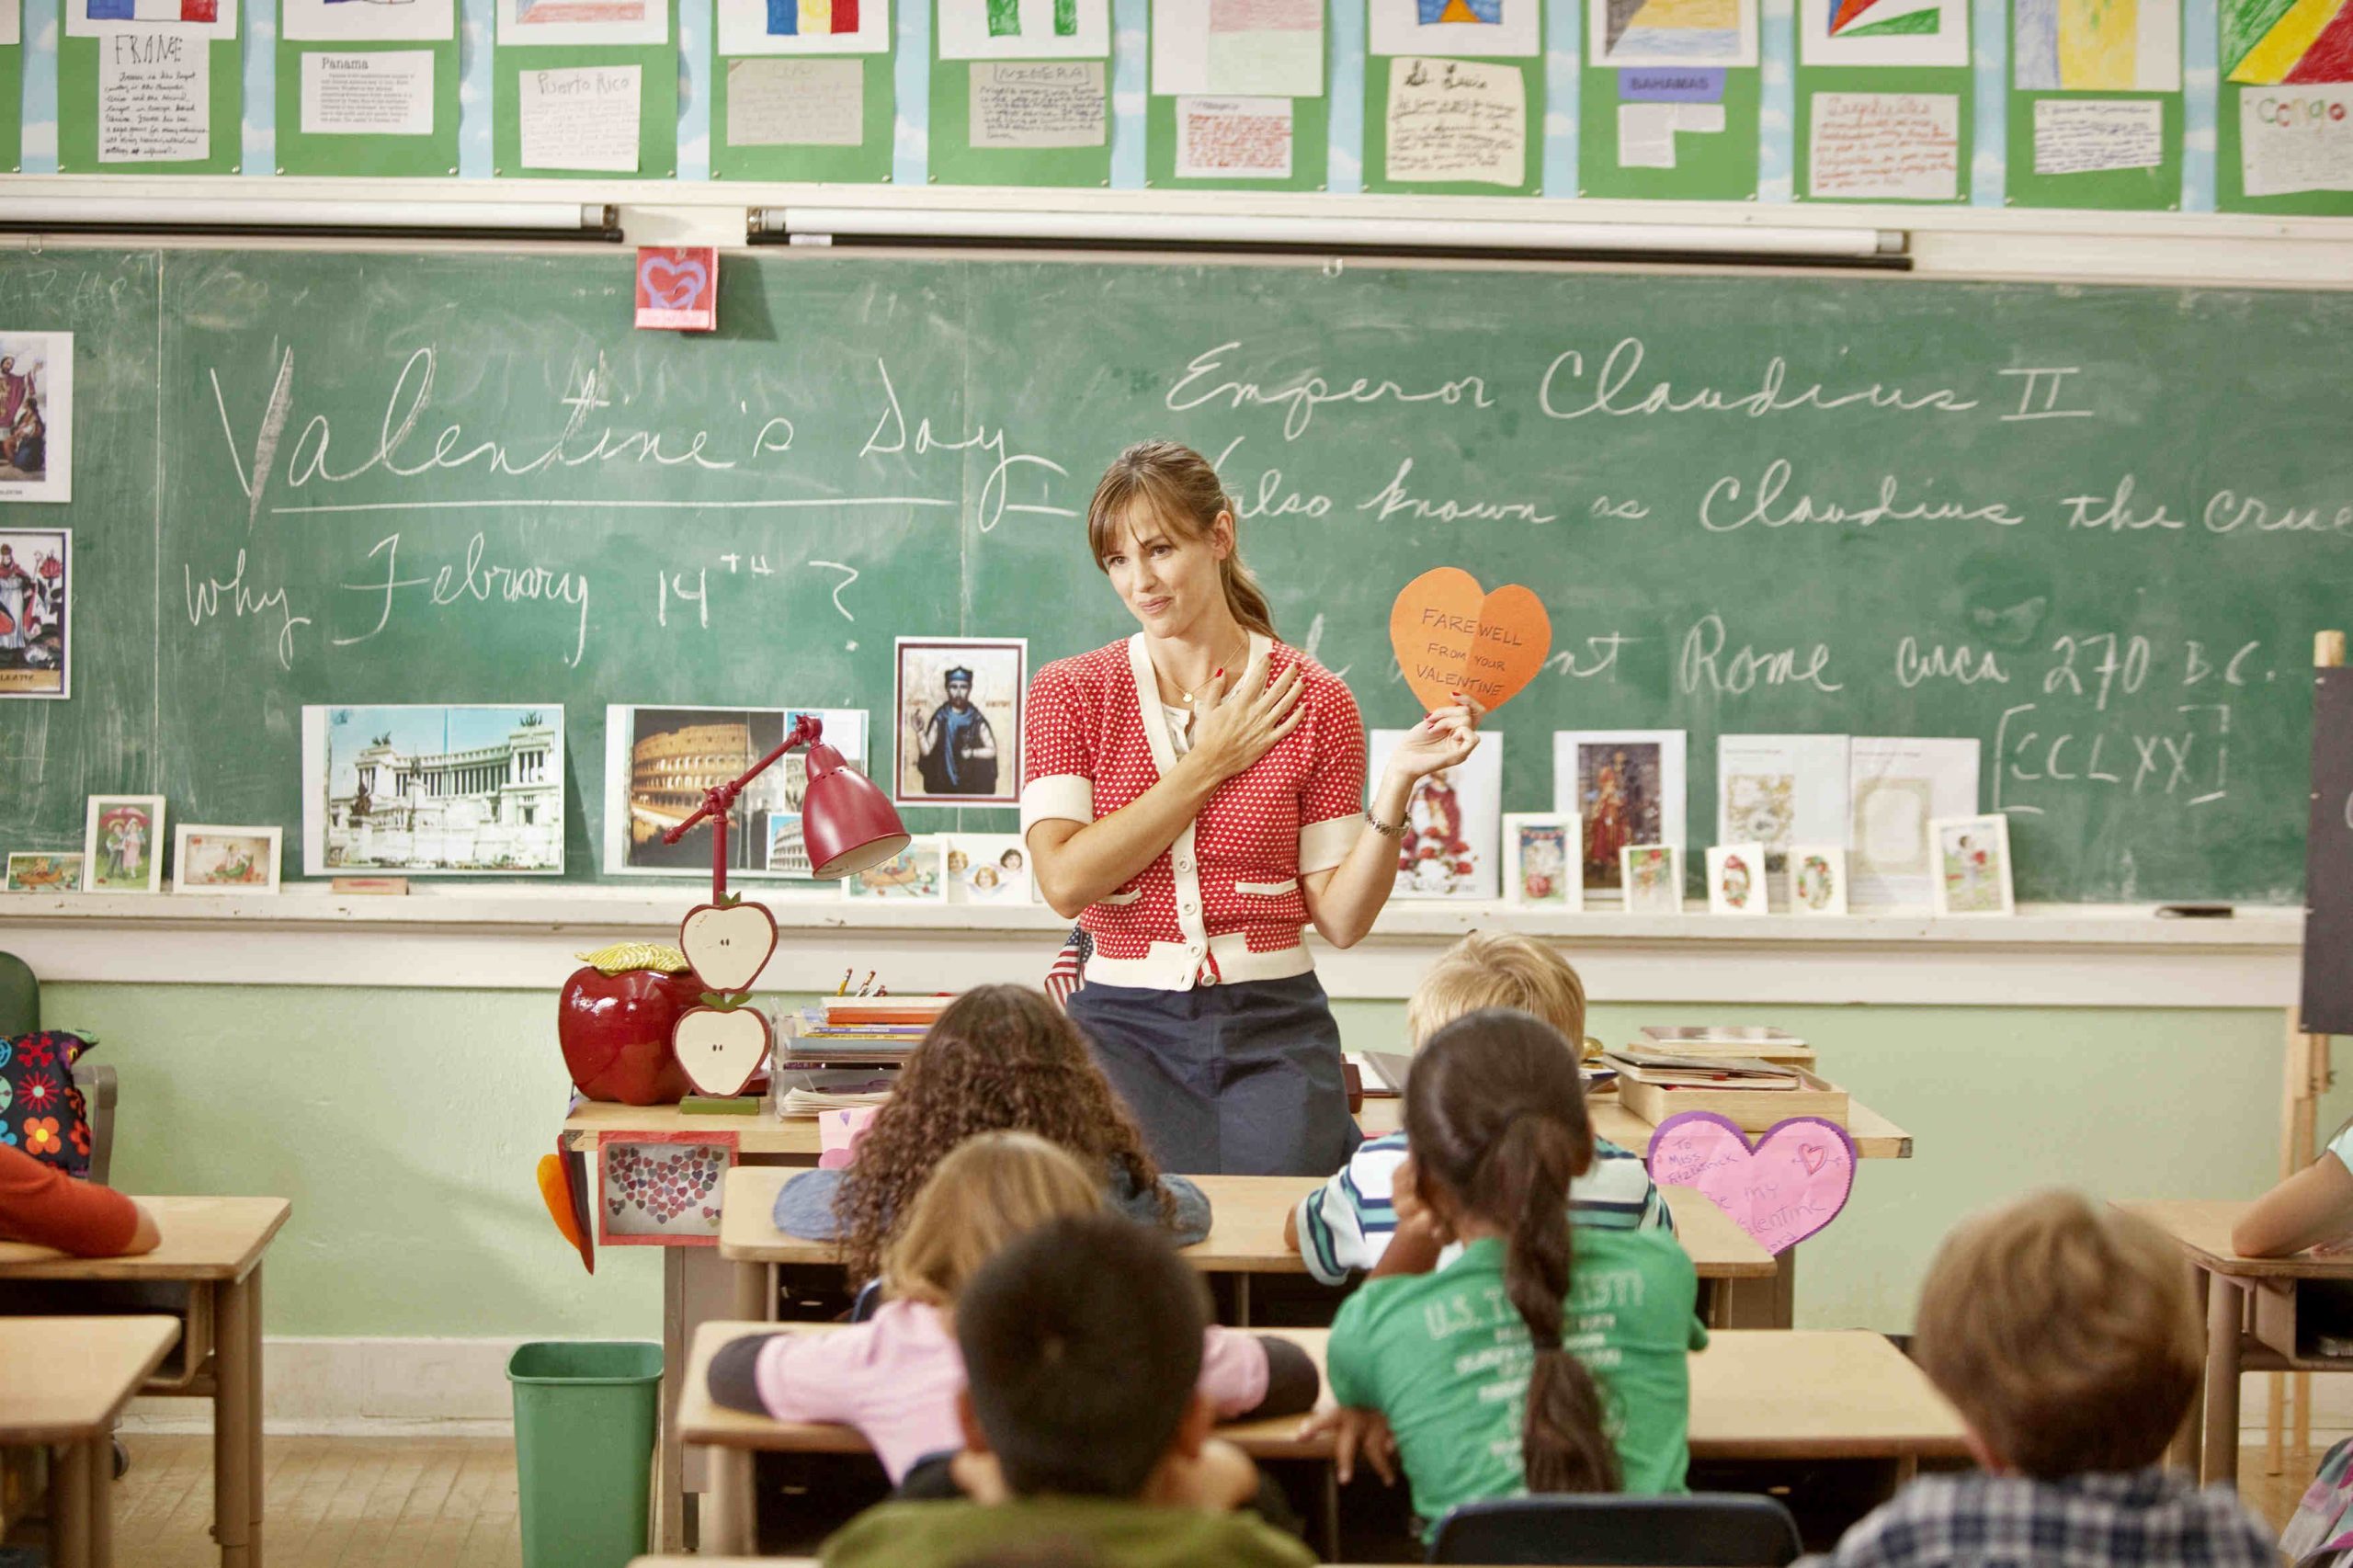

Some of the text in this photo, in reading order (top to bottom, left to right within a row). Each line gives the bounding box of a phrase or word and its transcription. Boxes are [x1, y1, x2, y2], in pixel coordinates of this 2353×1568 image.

[322, 57, 369, 70] Panama
[538, 72, 629, 95] Puerto Rico
[1631, 76, 1710, 91] BAHAMAS
[2256, 97, 2348, 132] Congo
[1165, 336, 2095, 442] Emperor Claudius II
[210, 342, 1071, 534] Valentine's Day
[1355, 458, 1558, 525] known
[1591, 494, 1652, 519] as
[1699, 458, 2026, 533] Claudius
[2058, 473, 2187, 533] the
[1421, 608, 1523, 647] FAREWELL
[1427, 642, 1506, 672] FROM YOUR
[1679, 612, 1845, 696] Rome
[2042, 631, 2153, 711] 270
[1415, 664, 1506, 697] VALENTINE
